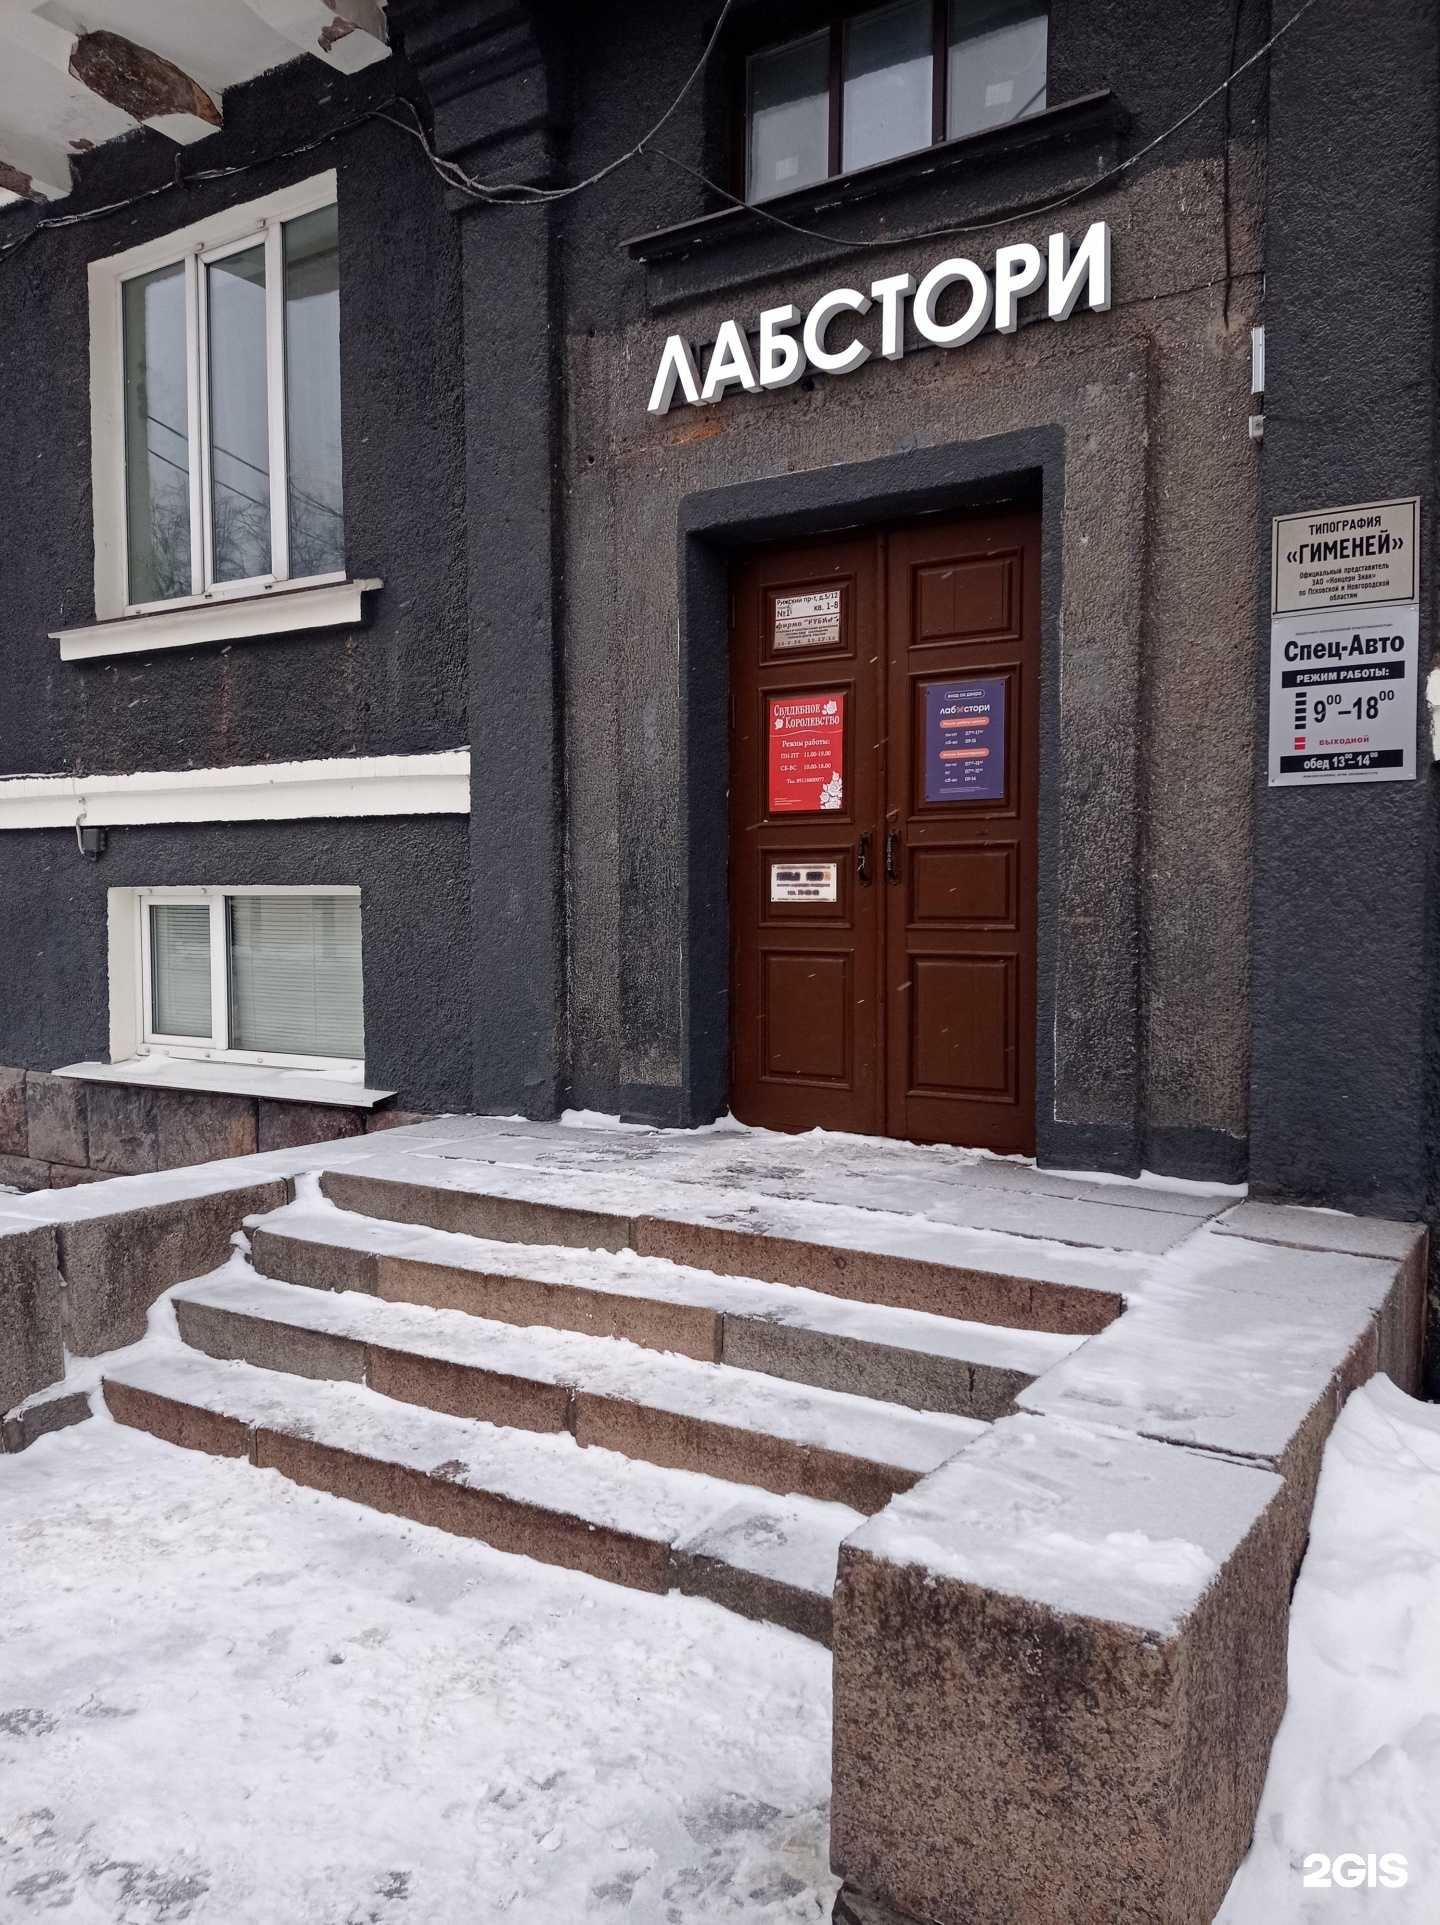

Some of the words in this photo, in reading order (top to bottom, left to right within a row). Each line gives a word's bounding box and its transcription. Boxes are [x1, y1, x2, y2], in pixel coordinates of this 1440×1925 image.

[647, 221, 1111, 415] ЛАБСТОРИ
[1309, 515, 1382, 536] ТИПОГРАФИЯ
[1286, 529, 1404, 564] «ГИМЕНЕЙ»
[1299, 567, 1342, 580] Официальный
[1343, 563, 1390, 575] представитель
[1312, 577, 1324, 586] ЗАО
[1284, 633, 1405, 663] Спец-Авто
[1296, 670, 1337, 684] РЕЖИМ
[1340, 667, 1390, 681] РАБОТЫ:
[1303, 757, 1330, 770] обед
